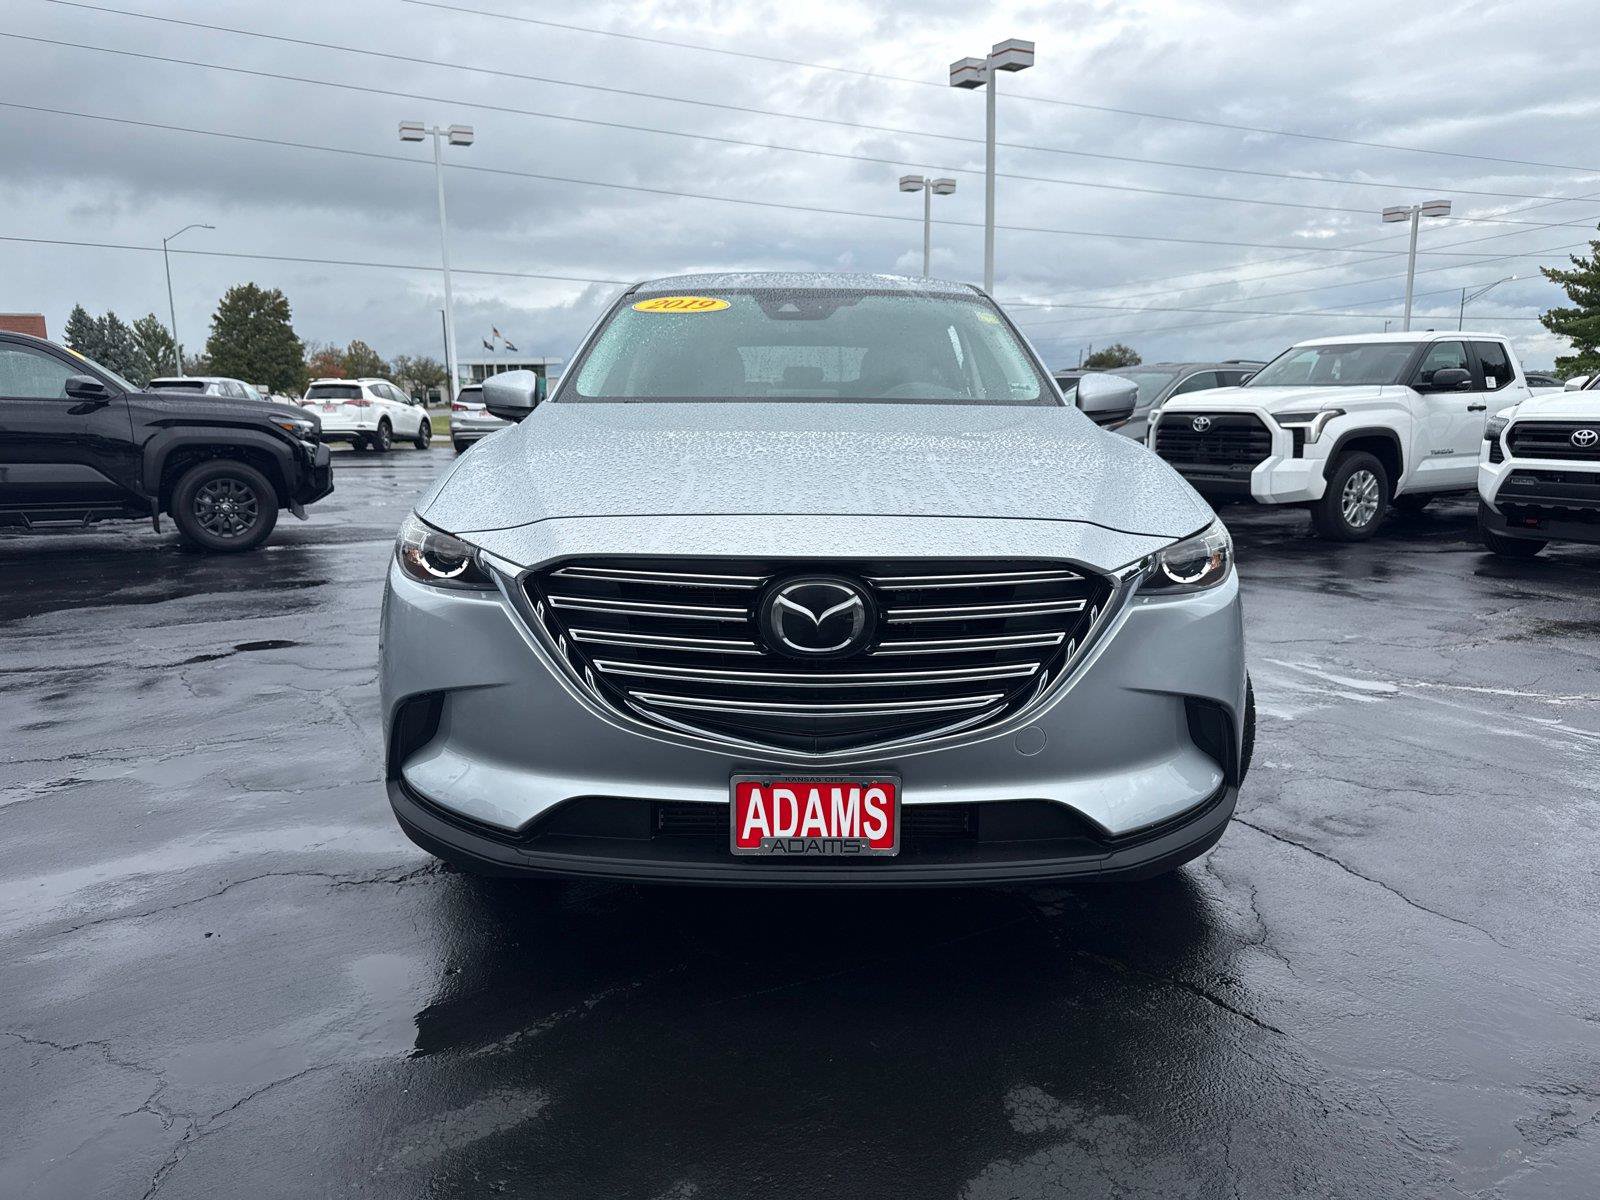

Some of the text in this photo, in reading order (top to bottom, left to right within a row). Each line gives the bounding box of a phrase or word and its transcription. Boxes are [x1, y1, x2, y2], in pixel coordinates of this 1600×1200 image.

[645, 299, 717, 310] 2019
[741, 787, 889, 841] ADAMS
[770, 839, 861, 854] ADAMS
